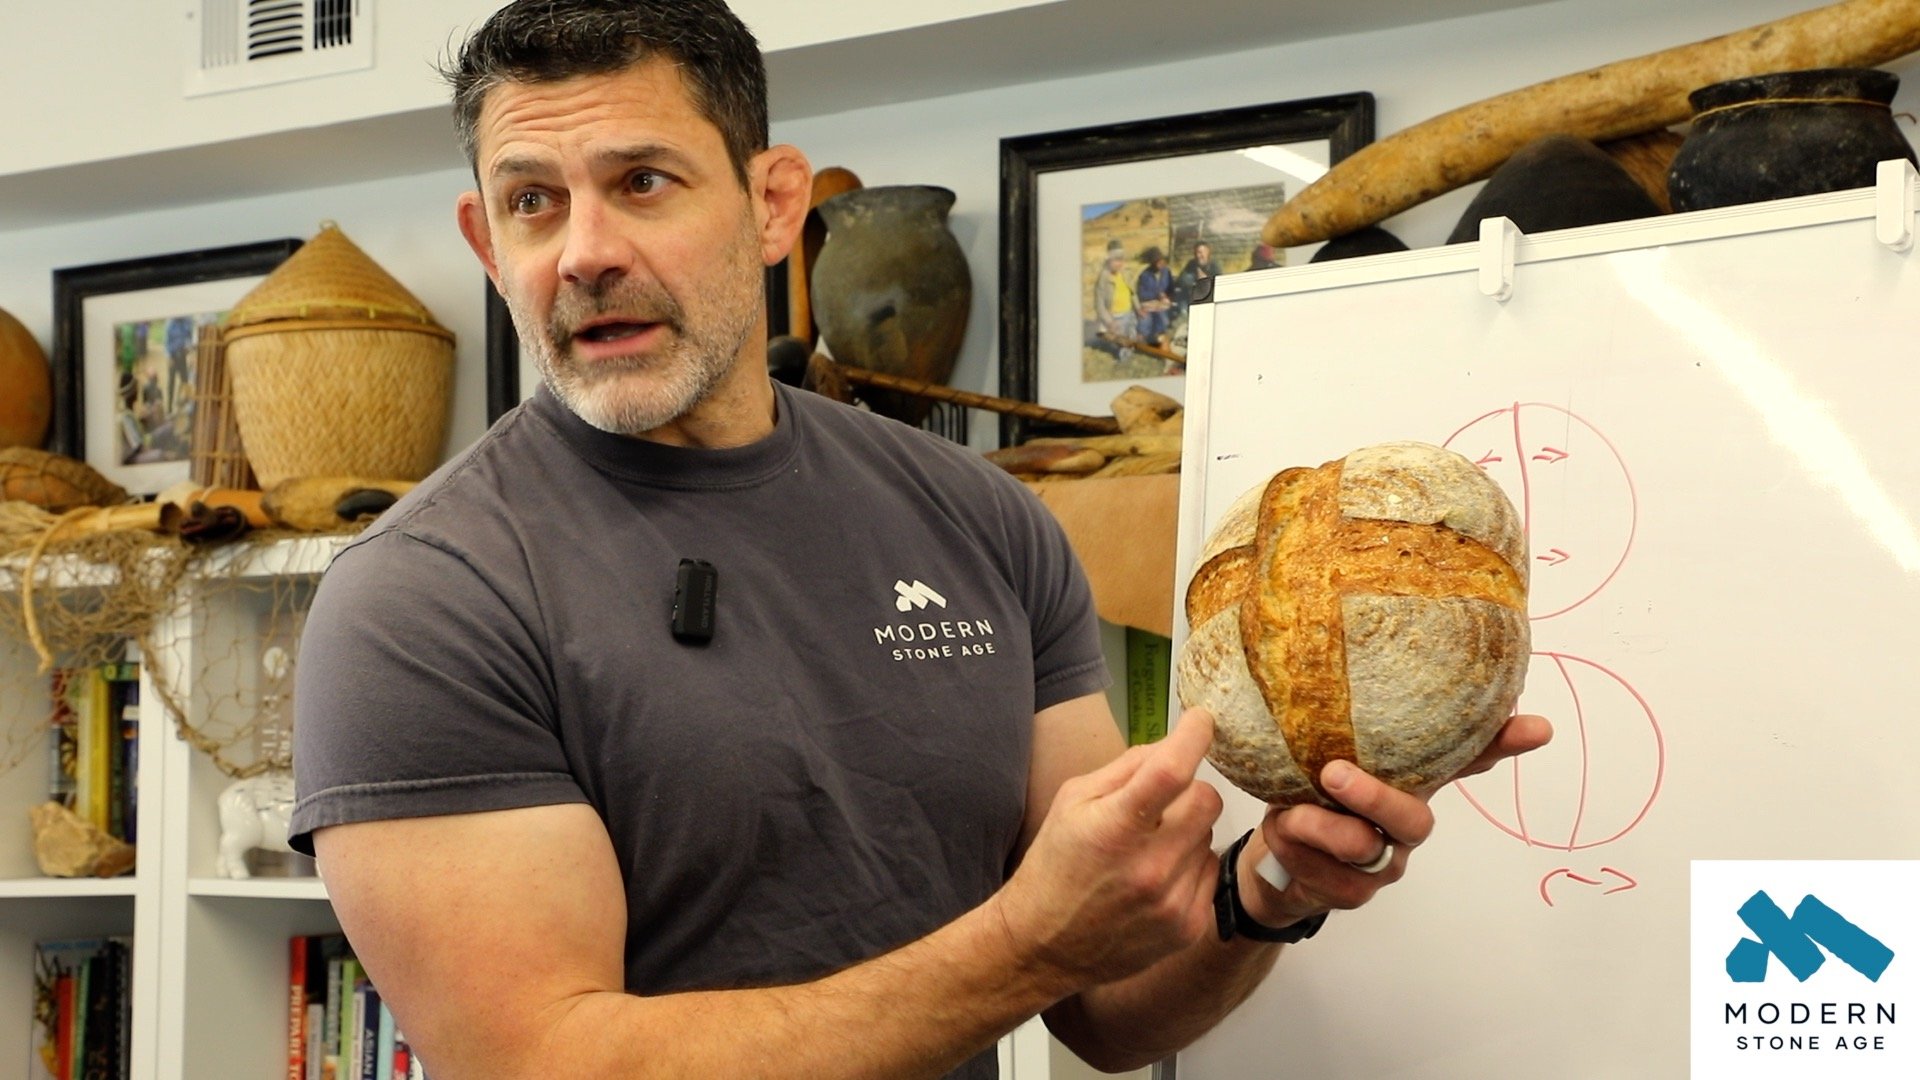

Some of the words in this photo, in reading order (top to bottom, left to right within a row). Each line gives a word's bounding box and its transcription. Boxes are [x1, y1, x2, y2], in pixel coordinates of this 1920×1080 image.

[873, 619, 994, 645] MODERN
[892, 645, 953, 661] STONE
[961, 642, 996, 657] AGE
[1142, 643, 1160, 717] Forgotten
[289, 985, 303, 1056] PREPARE
[363, 1028, 375, 1075] ASIAN
